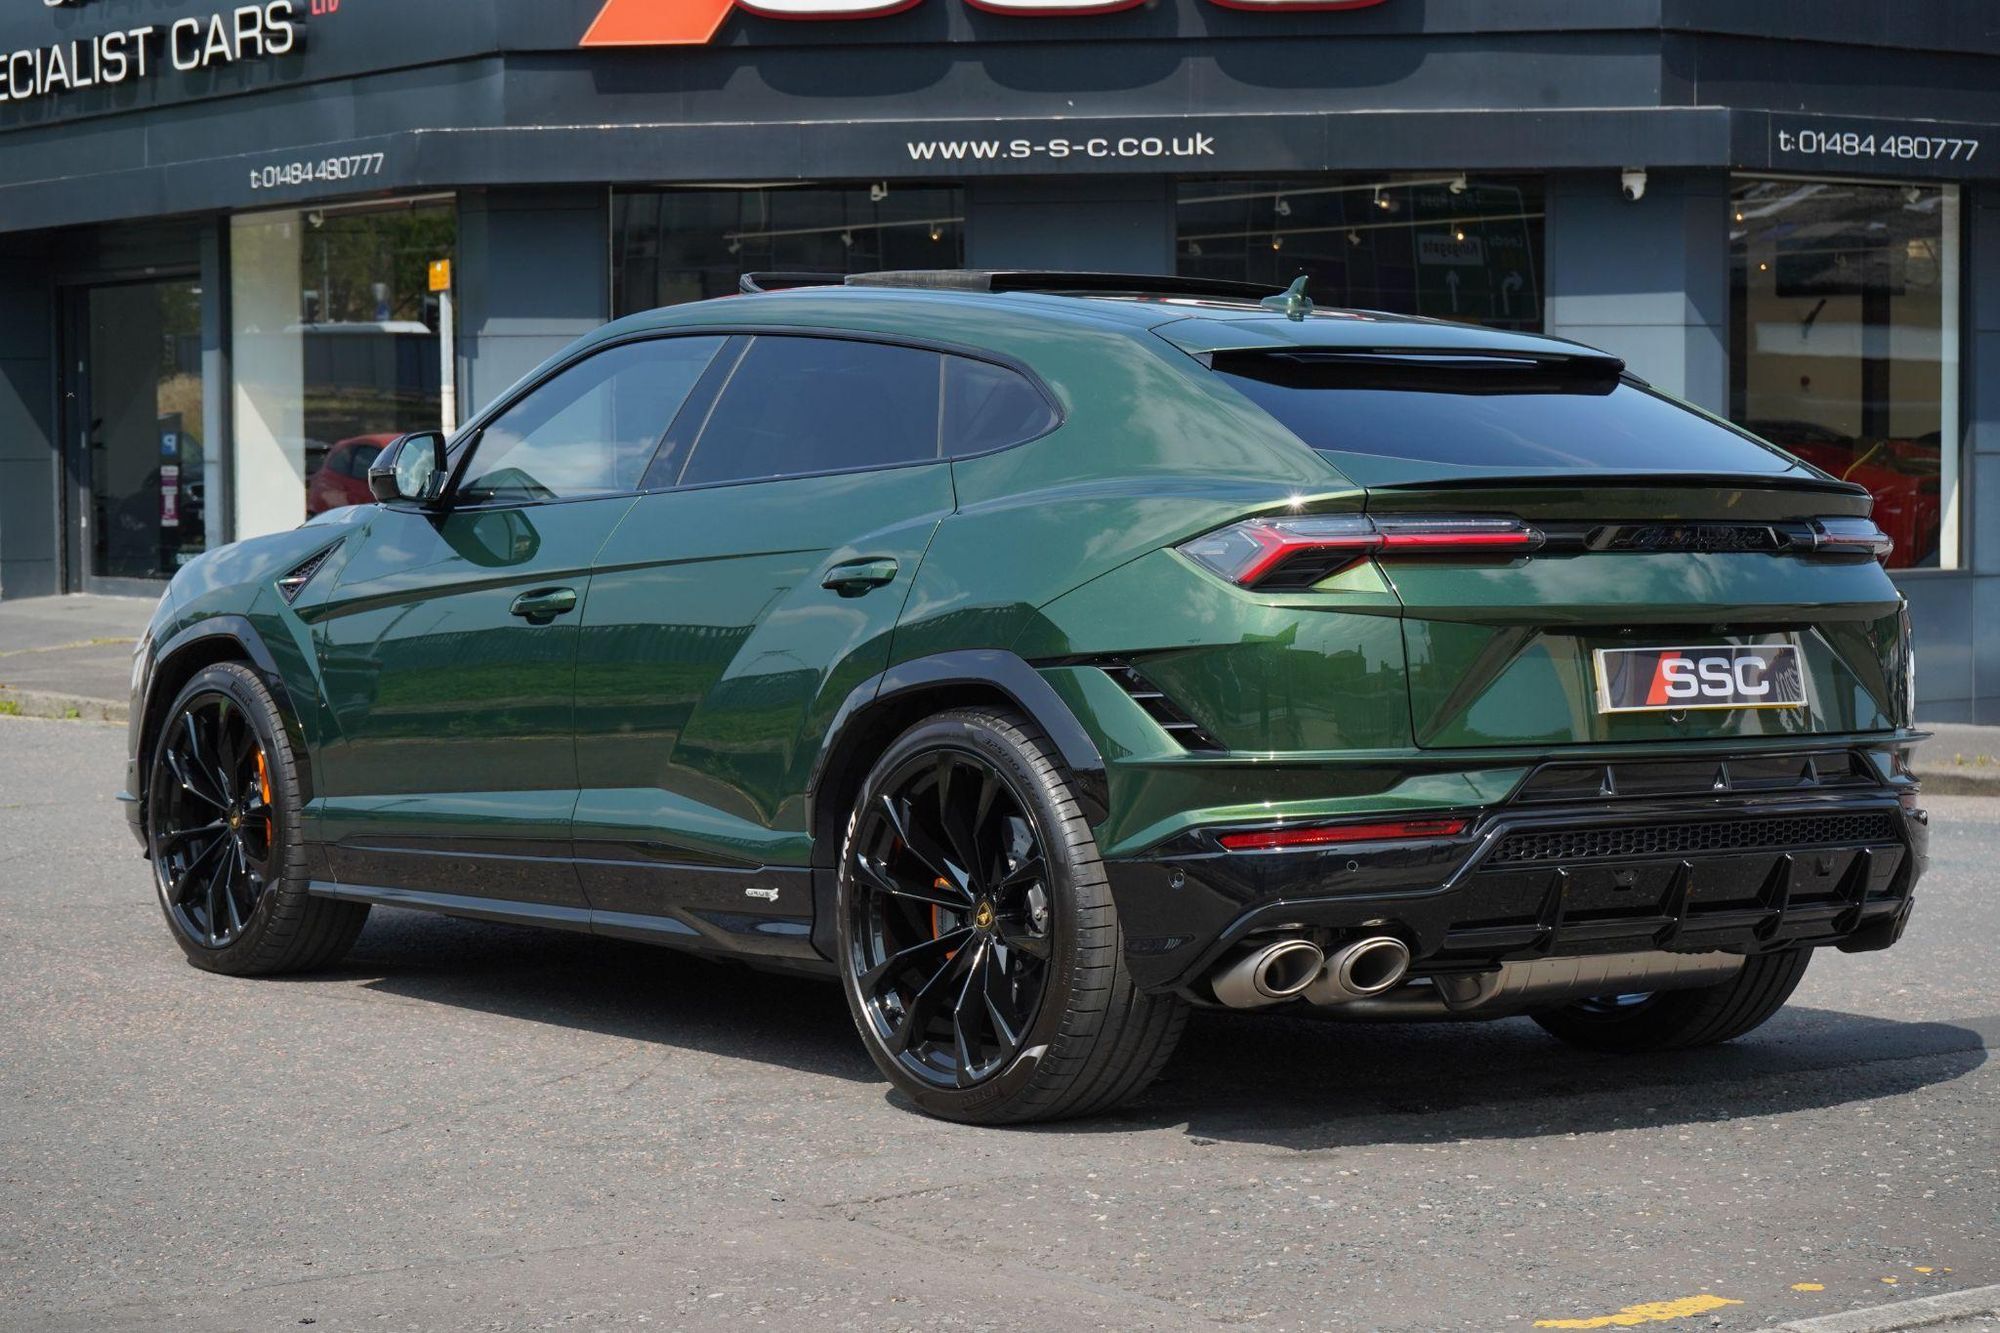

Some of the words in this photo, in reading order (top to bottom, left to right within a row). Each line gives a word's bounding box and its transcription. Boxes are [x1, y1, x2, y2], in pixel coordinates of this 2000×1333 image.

[171, 0, 293, 70] CARS
[907, 132, 1215, 160] www.s-s-c.co.uk
[1880, 135, 1979, 161] 480777
[314, 152, 384, 180] 480777
[1661, 656, 1770, 698] SSC
